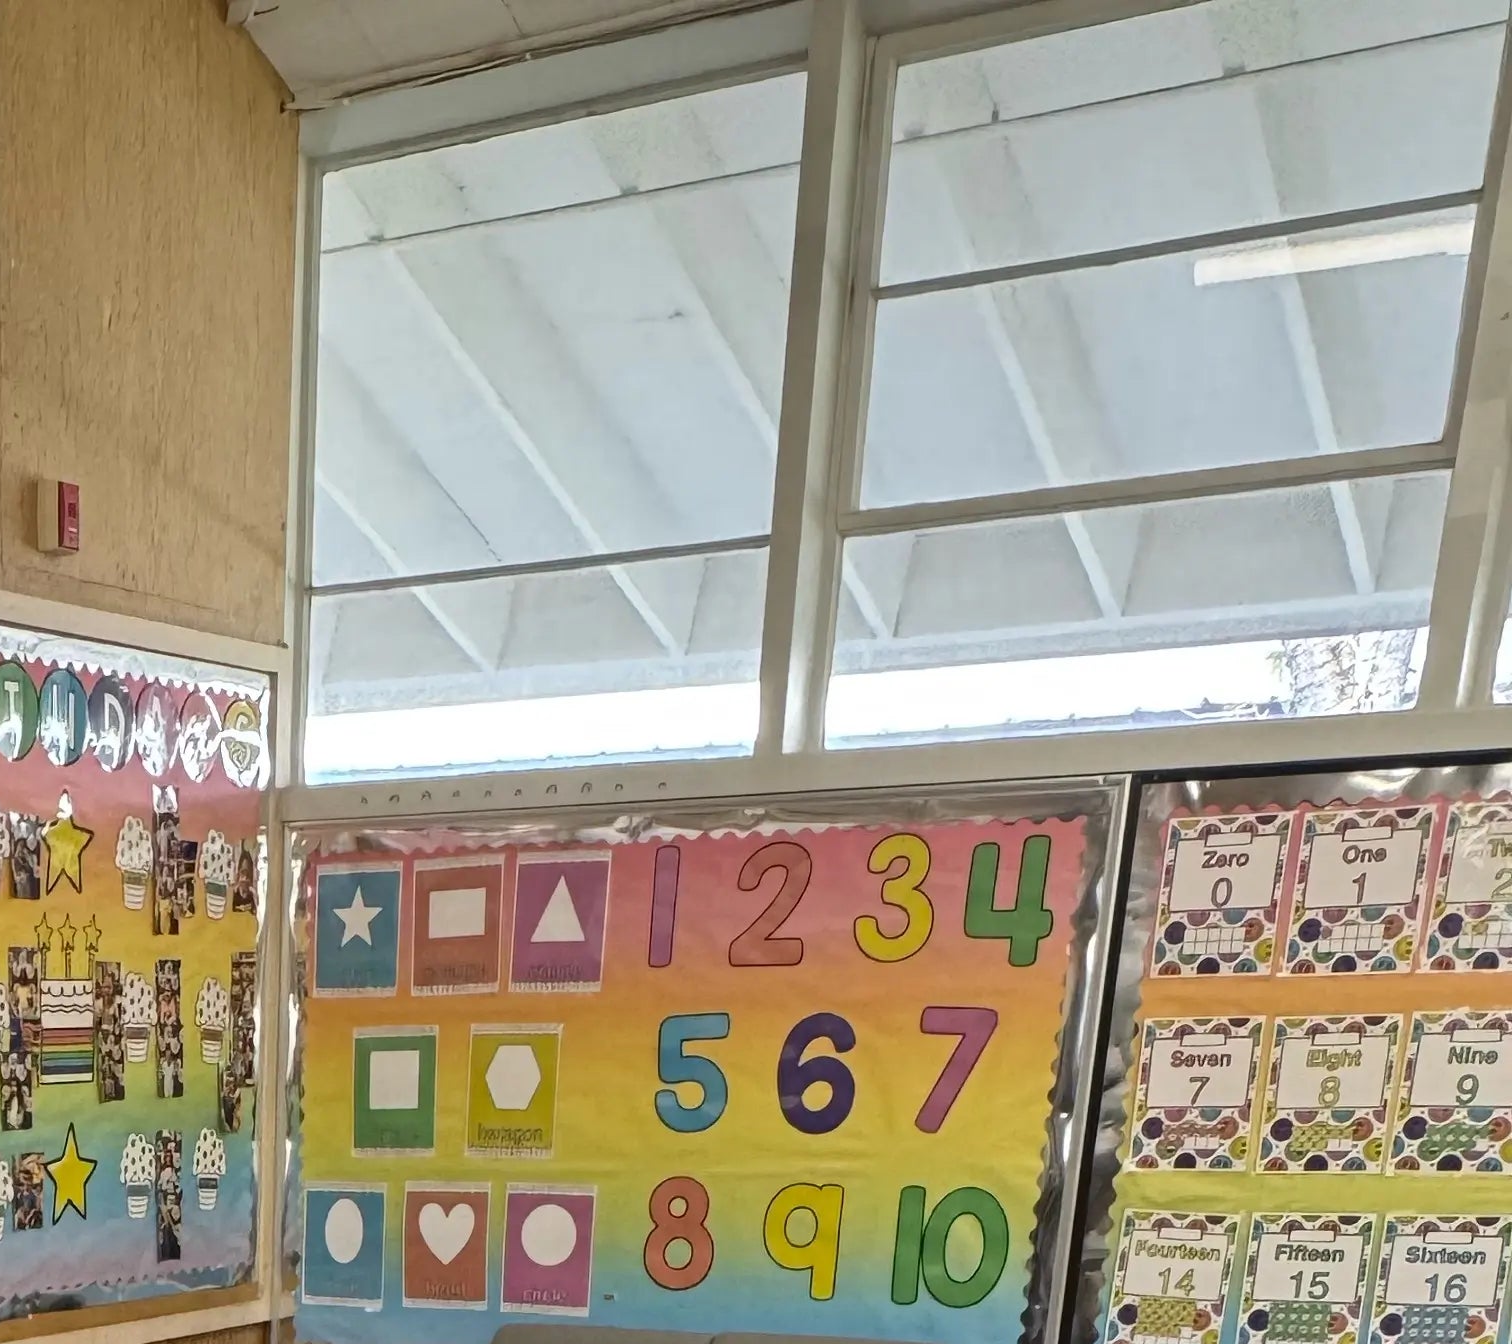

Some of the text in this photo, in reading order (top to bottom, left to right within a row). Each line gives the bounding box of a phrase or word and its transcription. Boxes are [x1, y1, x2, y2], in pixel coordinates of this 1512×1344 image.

[1202, 849, 1250, 871] Zero
[1342, 844, 1388, 865] One
[648, 832, 1054, 967] 1 2 3 4
[1211, 876, 1233, 909] 0
[1352, 872, 1368, 904] 1
[654, 1006, 999, 1135] 5 6 7
[1170, 1049, 1232, 1068] Seven
[1306, 1048, 1363, 1072] Eight
[1448, 1046, 1499, 1065] Nine
[1189, 1076, 1211, 1106] 7
[1318, 1075, 1341, 1107] 8
[1456, 1073, 1479, 1106] 9
[643, 1176, 1009, 1308] 8 9 10
[1135, 1239, 1222, 1262] Fourteen
[1274, 1243, 1346, 1264] Fifteen
[1405, 1246, 1487, 1266] Sixteen
[1158, 1266, 1196, 1297] 14
[1289, 1271, 1330, 1301] 15
[1424, 1273, 1468, 1303] 16
